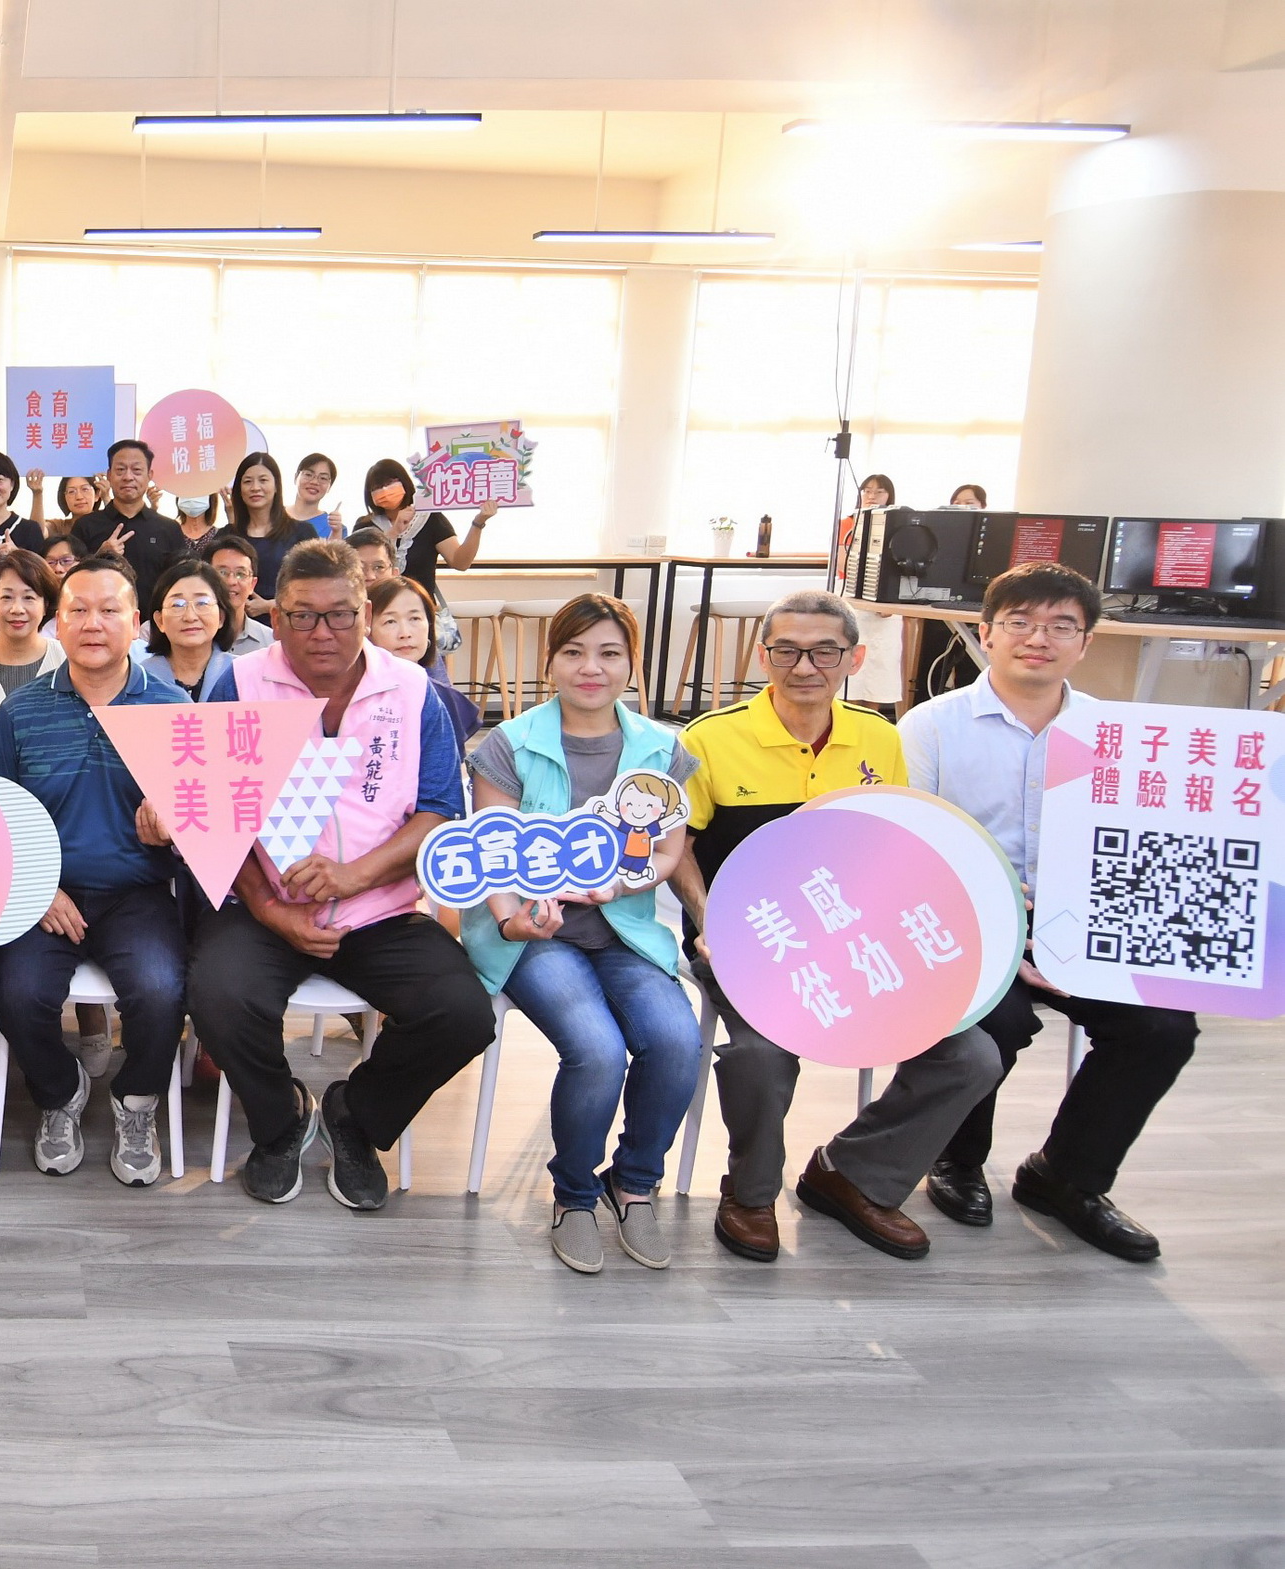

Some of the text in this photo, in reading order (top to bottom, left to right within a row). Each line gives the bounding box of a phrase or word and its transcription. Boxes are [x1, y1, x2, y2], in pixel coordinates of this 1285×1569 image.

[26, 390, 68, 417] 食育
[171, 413, 214, 442] 書福
[26, 422, 93, 449] 美學堂
[171, 444, 216, 474] 悅讀
[428, 460, 517, 505] 悅讀
[171, 710, 263, 767] 美域
[1094, 721, 1266, 771] 親子美感
[361, 736, 386, 802] 黃能哲
[1091, 766, 1261, 816] 體驗報名
[173, 776, 263, 833] 美育
[435, 829, 608, 887] 五育全才
[744, 865, 862, 965] 美感
[789, 901, 964, 1029] 從幼起
